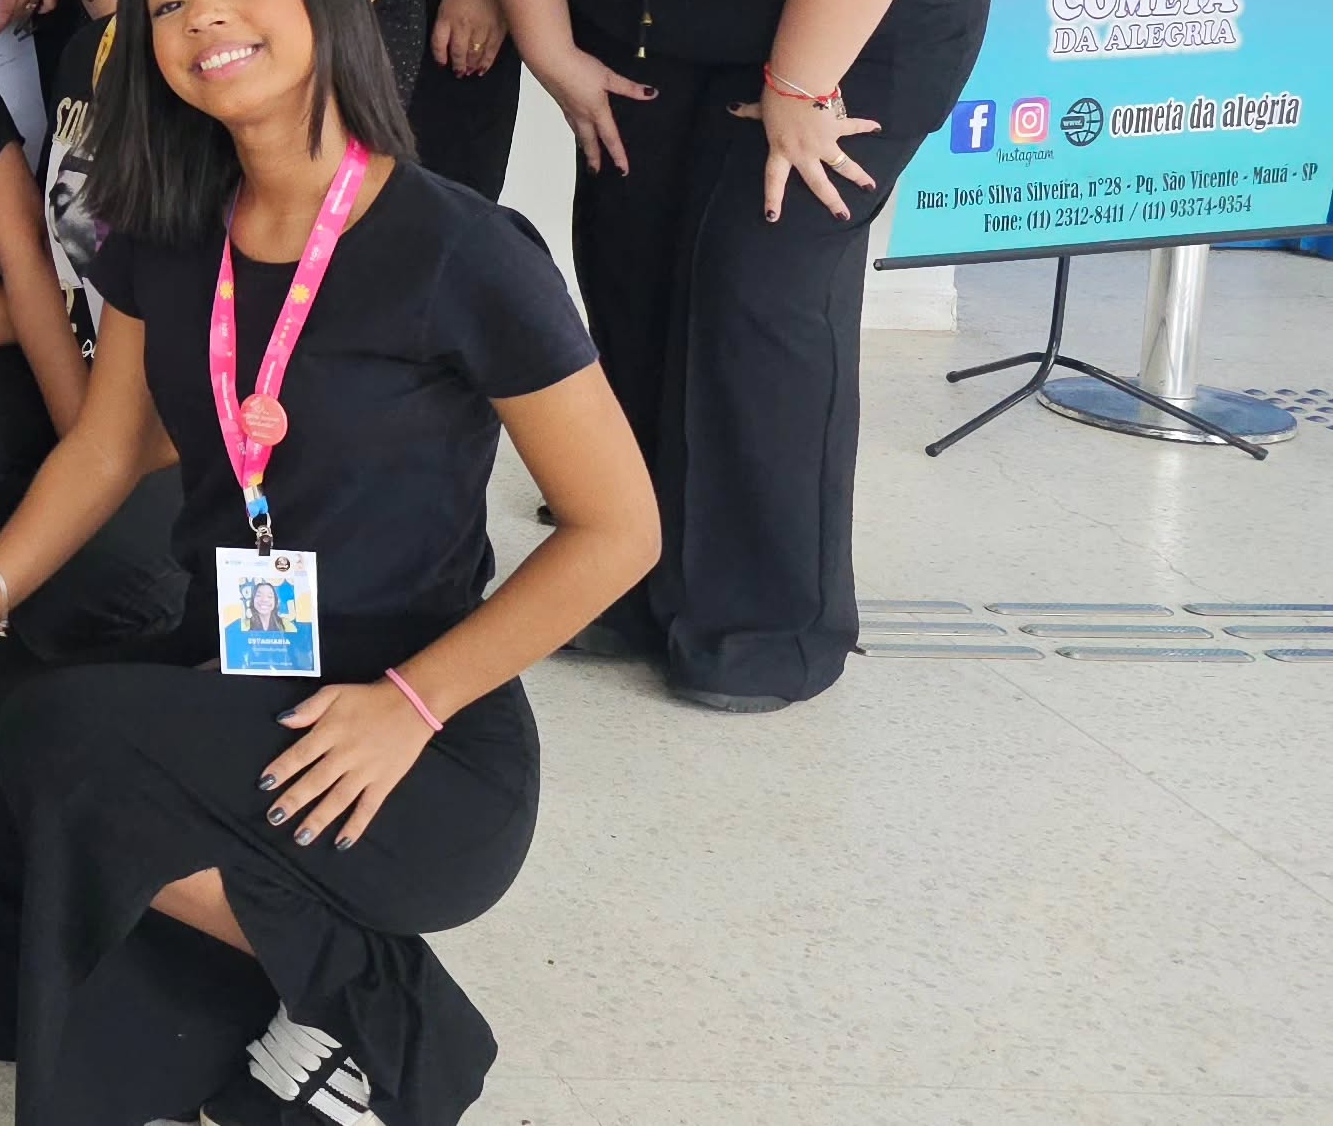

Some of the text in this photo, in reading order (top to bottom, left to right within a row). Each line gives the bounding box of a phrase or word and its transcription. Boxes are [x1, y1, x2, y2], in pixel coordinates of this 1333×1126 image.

[1053, 19, 1236, 54] DA ALEGRIA
[1110, 93, 1300, 136] cometa da alegria
[996, 147, 1055, 168] Instagram
[916, 190, 948, 210] Rua:
[952, 185, 984, 209] José
[988, 184, 1022, 205] Silva
[1026, 179, 1083, 202] Silveira,
[1135, 174, 1158, 196] Pq.
[1162, 170, 1186, 192] São
[1191, 168, 1239, 190] Vicente
[1252, 163, 1289, 186] Mauá
[1301, 162, 1319, 182] SP
[984, 213, 1023, 233] Fone:
[1026, 209, 1051, 231] (11)
[1054, 203, 1124, 227] 2312-8411
[1142, 200, 1166, 222] (11)
[1169, 193, 1252, 218] 93374-9354
